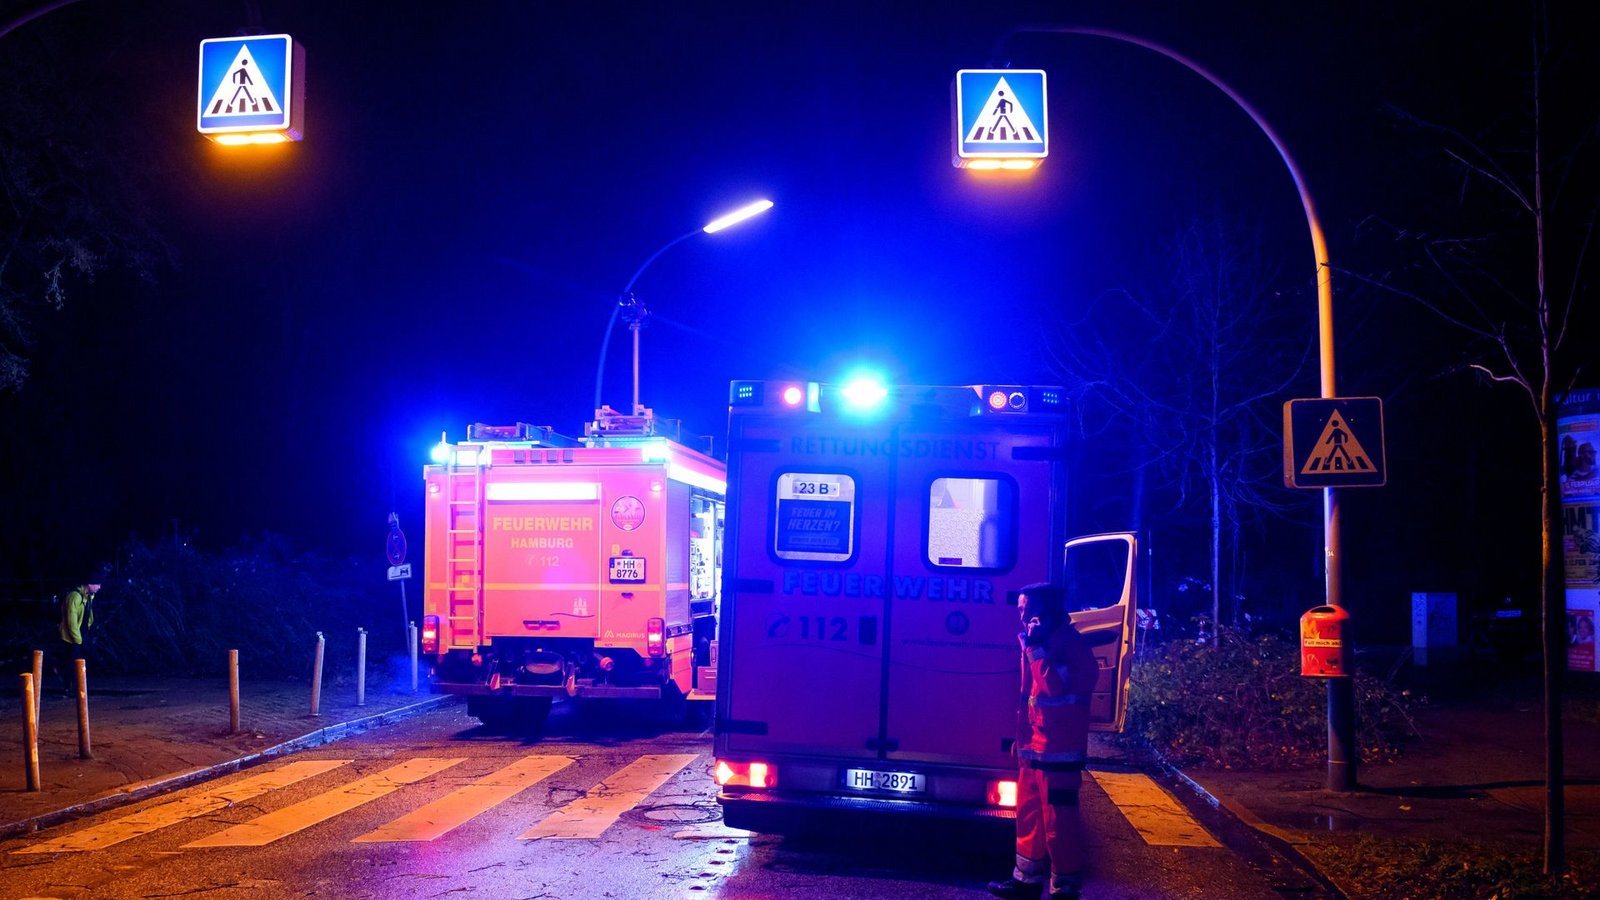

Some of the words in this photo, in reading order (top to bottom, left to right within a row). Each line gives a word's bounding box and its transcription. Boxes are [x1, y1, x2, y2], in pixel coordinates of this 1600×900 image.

[791, 436, 1000, 460] RETTUNGSDIENST
[799, 482, 815, 495] 23
[820, 483, 829, 494] B
[493, 516, 593, 531] FEUERWEHR
[787, 518, 840, 532] HERZEN?
[511, 537, 574, 549] HAMBURG
[540, 555, 560, 567] 112
[623, 560, 635, 569] HH
[616, 569, 638, 578] 8776
[798, 615, 849, 641] 112
[854, 771, 874, 787] HH
[881, 773, 918, 790] 2891
